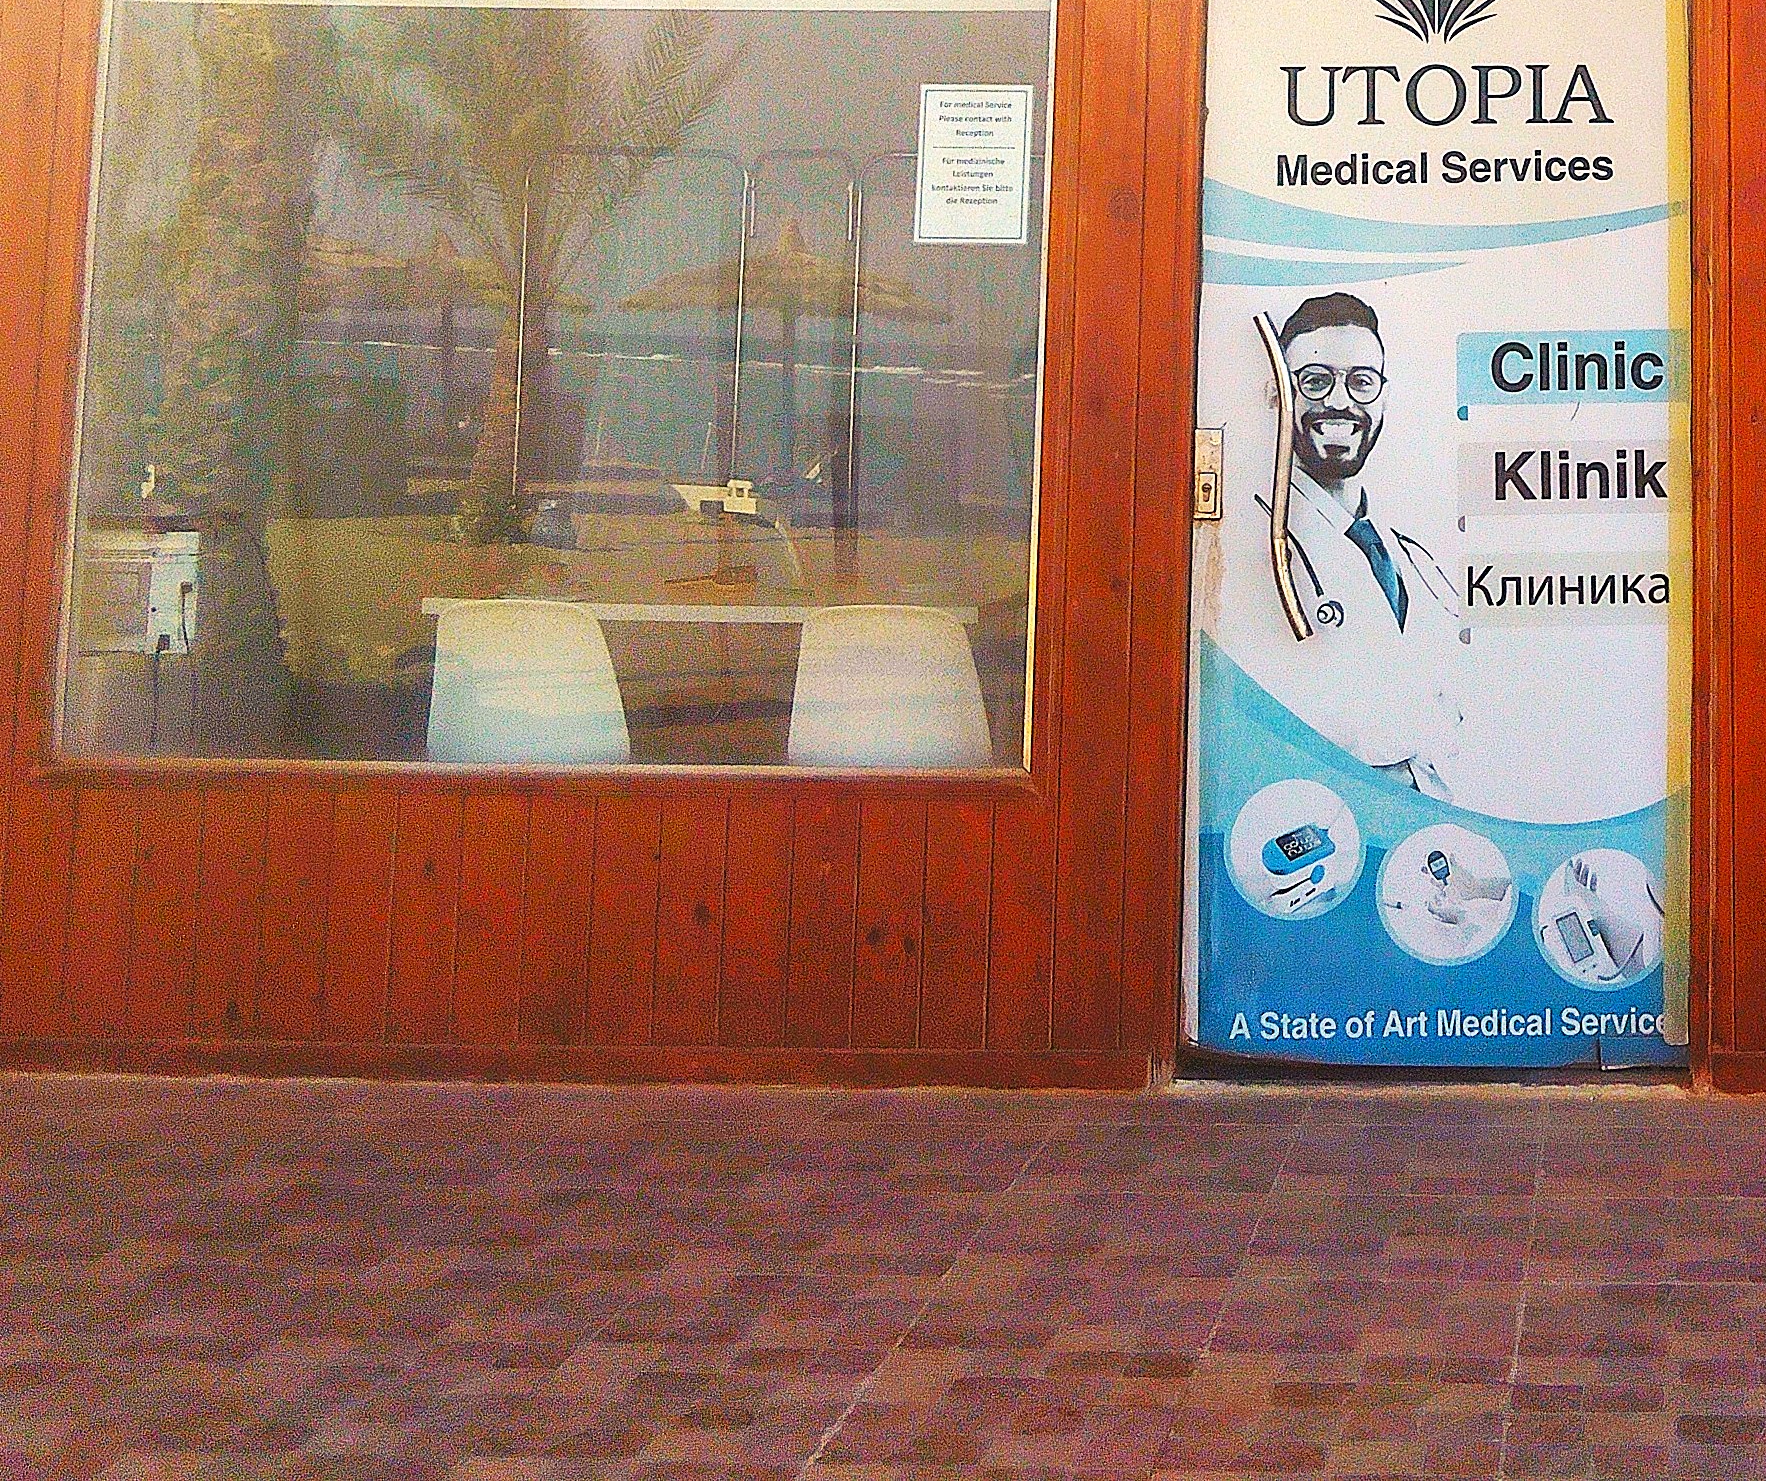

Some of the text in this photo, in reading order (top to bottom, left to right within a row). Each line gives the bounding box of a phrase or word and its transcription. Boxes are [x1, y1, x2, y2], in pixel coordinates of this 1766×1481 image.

[953, 101, 984, 109] medical
[985, 101, 1012, 109] Service
[1279, 64, 1615, 127] UTOPIA
[956, 129, 994, 138] Reception
[942, 157, 955, 165] Für
[1276, 149, 1614, 186] Medical Services
[952, 170, 994, 179] Leistungen
[982, 184, 994, 192] Sie
[945, 197, 998, 205] die Rezeption
[1491, 340, 1664, 393] Clinic
[1494, 449, 1668, 501] Klinik
[1467, 565, 1671, 607] Клиника
[1229, 1012, 1251, 1040] A
[1260, 1011, 1337, 1040] State
[1345, 1010, 1375, 1039] of
[1383, 1009, 1428, 1038] Art
[1437, 1008, 1551, 1037] Medical
